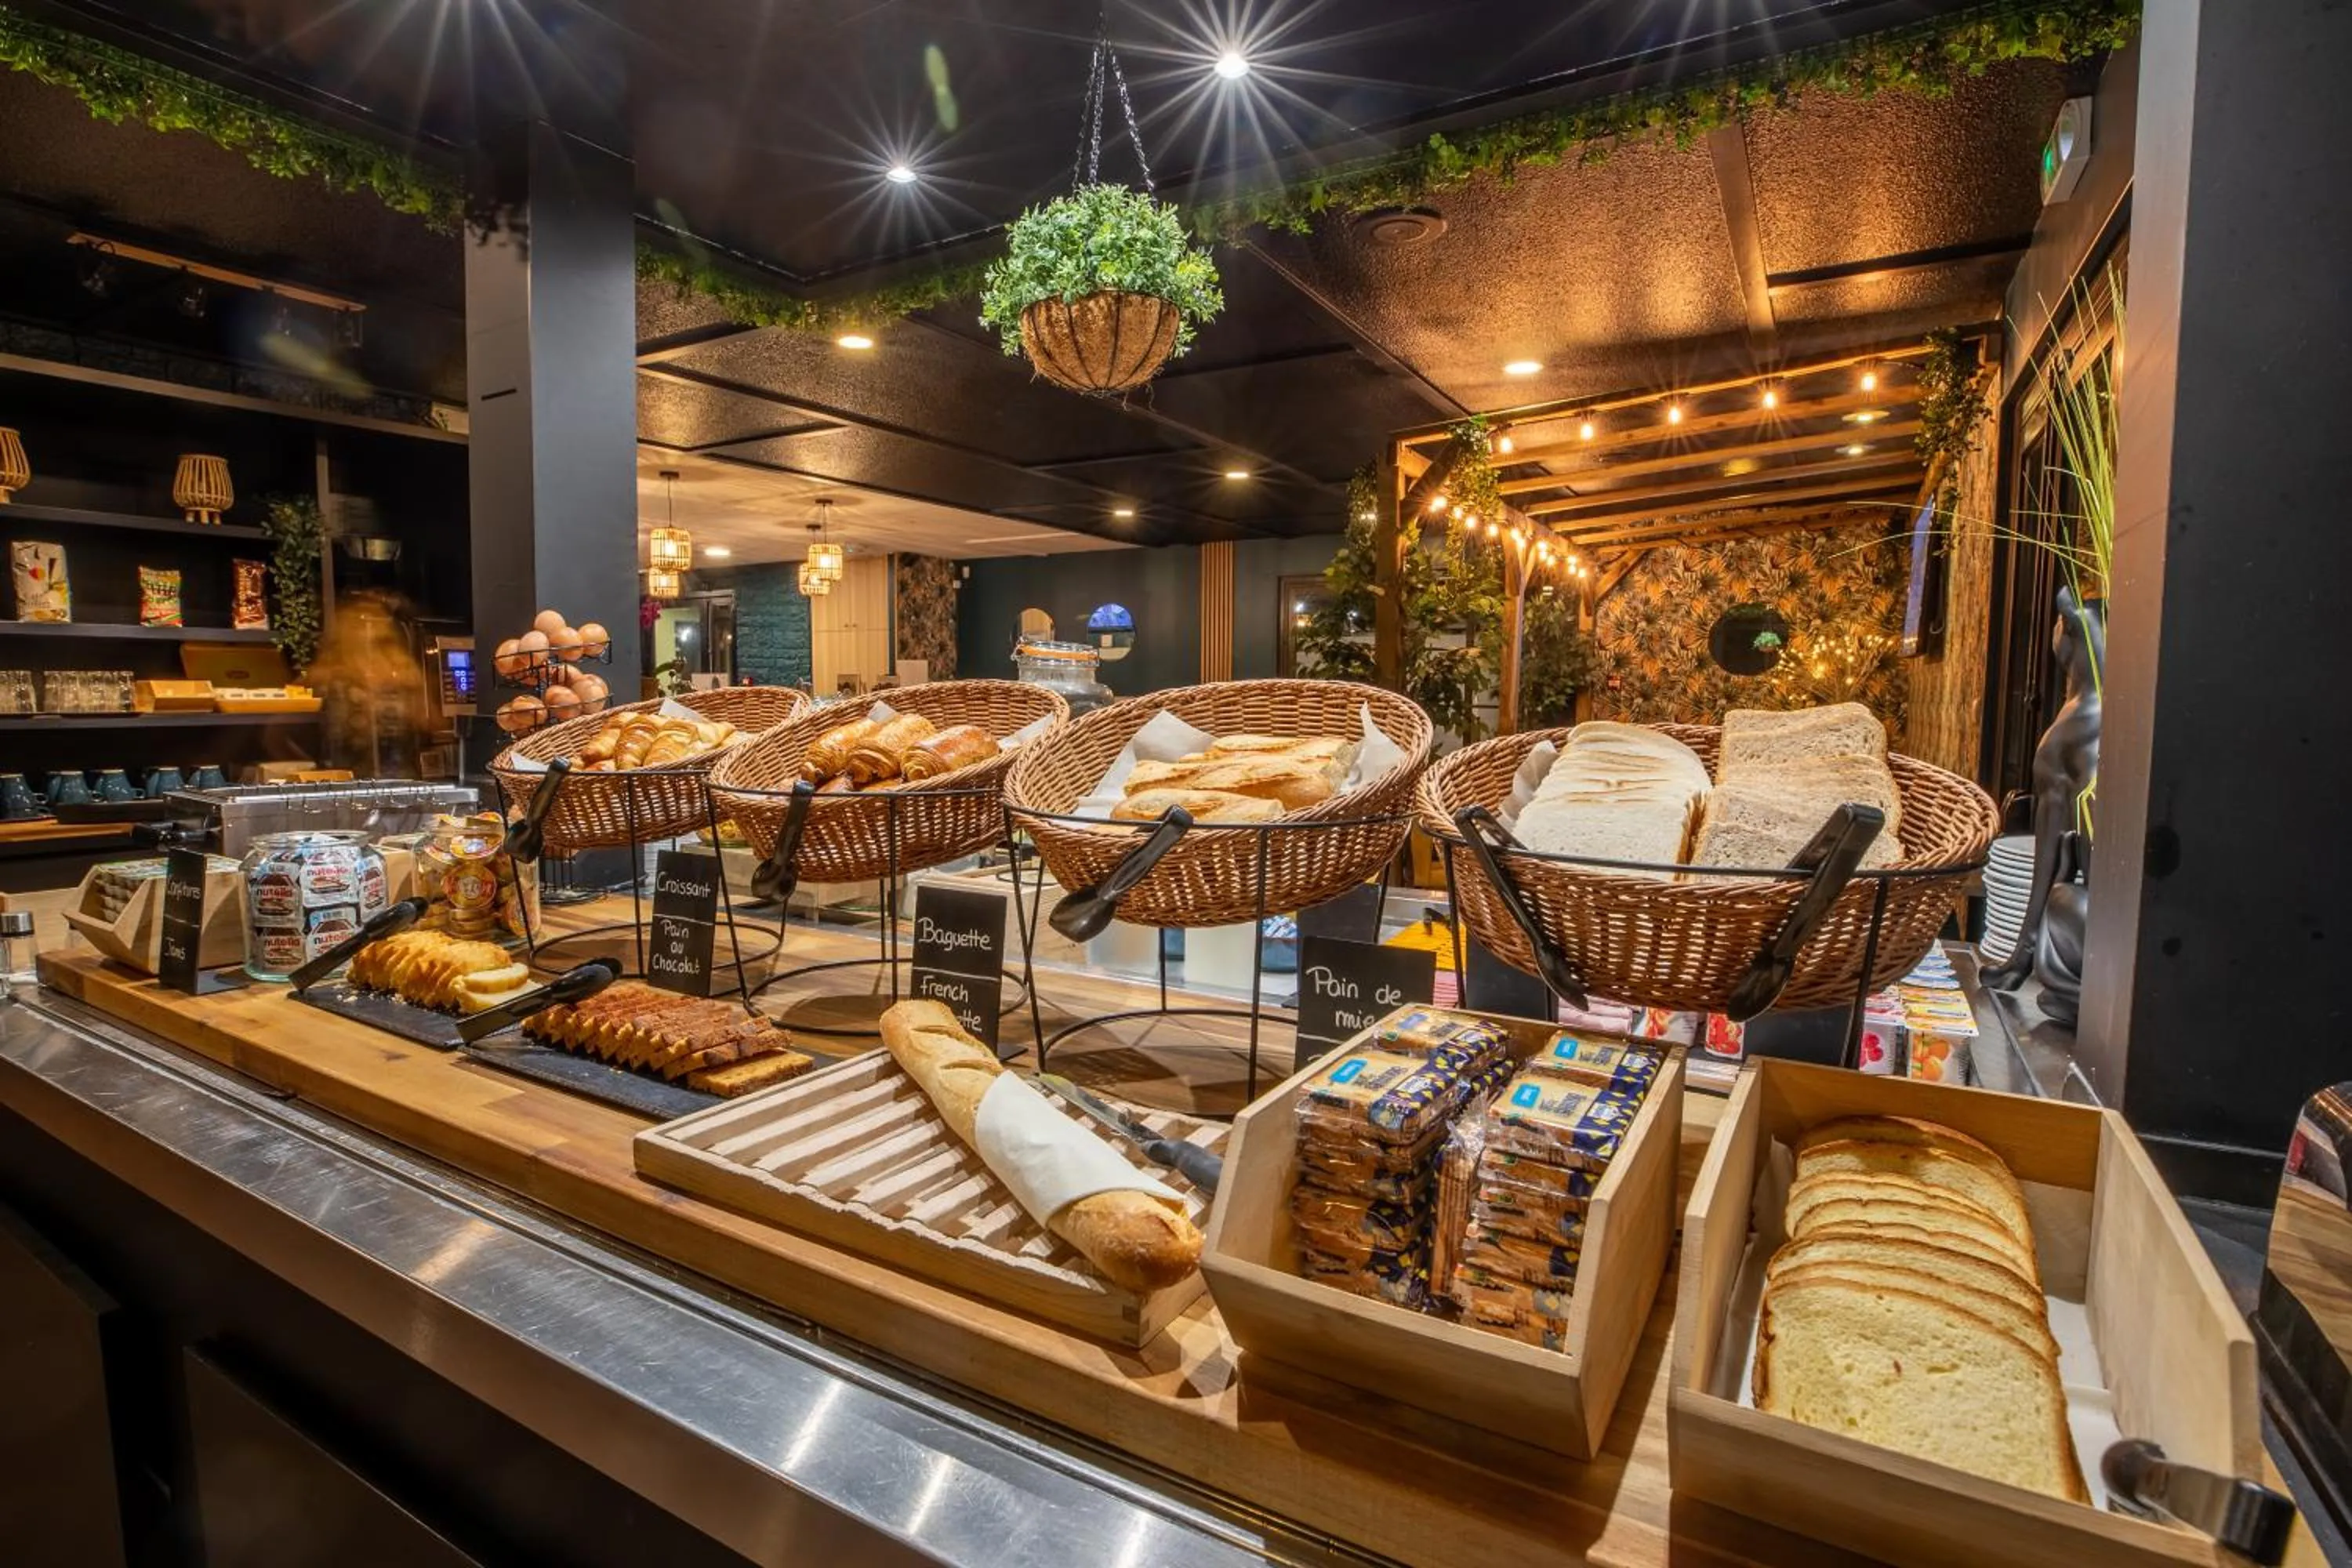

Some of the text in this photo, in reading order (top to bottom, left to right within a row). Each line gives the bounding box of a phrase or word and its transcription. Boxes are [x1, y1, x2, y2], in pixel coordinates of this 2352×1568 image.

[256, 887, 293, 898] nutella
[656, 871, 711, 898] Croissant
[660, 920, 690, 938] Pain
[918, 916, 992, 951] Baguette
[265, 936, 301, 947] nutella
[652, 953, 701, 975] Chocolat
[920, 975, 969, 1004] French
[1305, 965, 1403, 1006] Pain de
